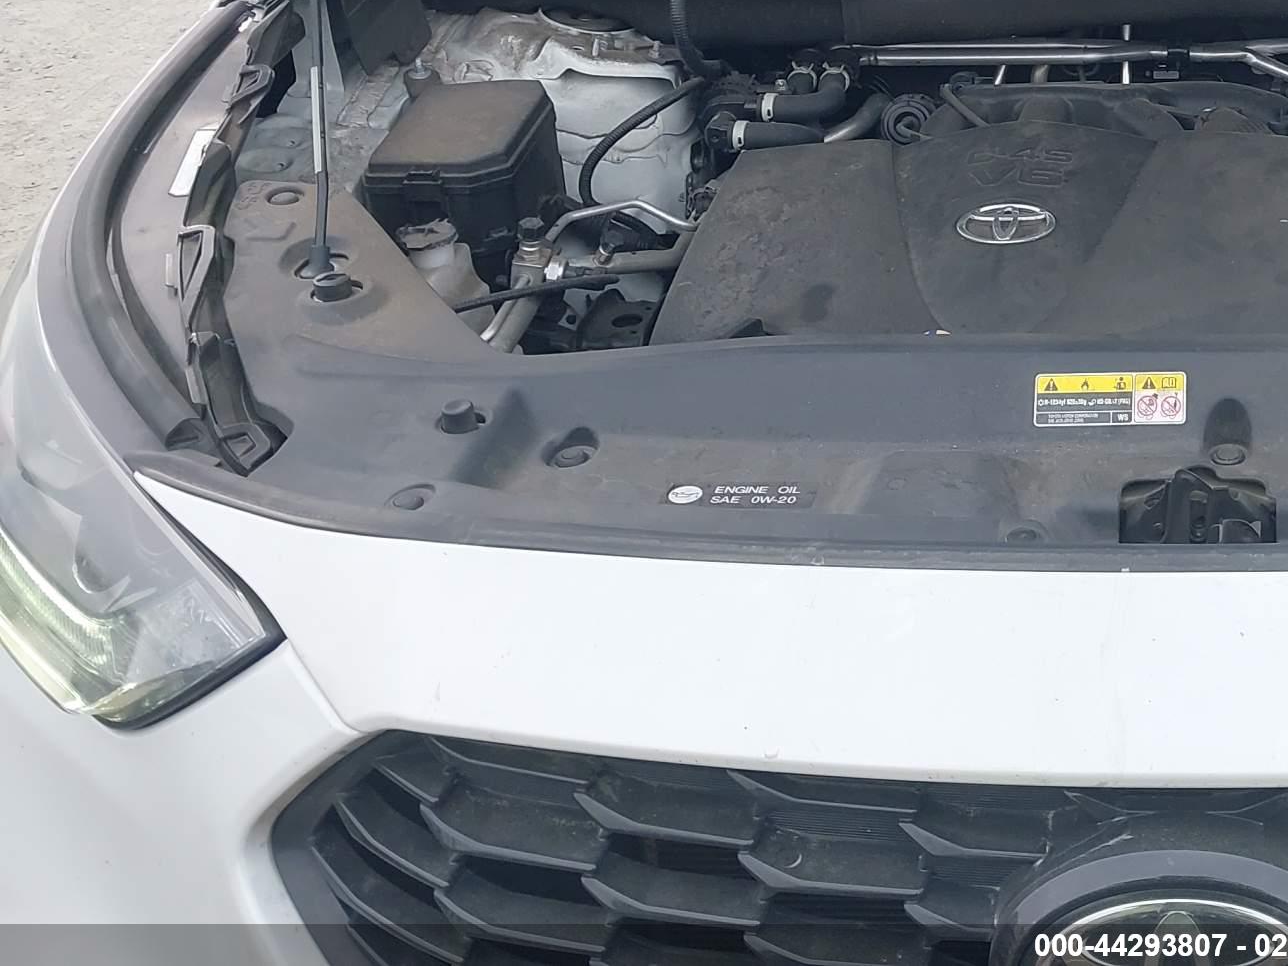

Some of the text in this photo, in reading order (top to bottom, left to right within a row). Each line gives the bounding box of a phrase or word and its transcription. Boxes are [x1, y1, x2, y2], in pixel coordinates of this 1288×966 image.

[714, 486, 800, 494] ENGINE OIL
[710, 495, 797, 504] SAE 0W-20
